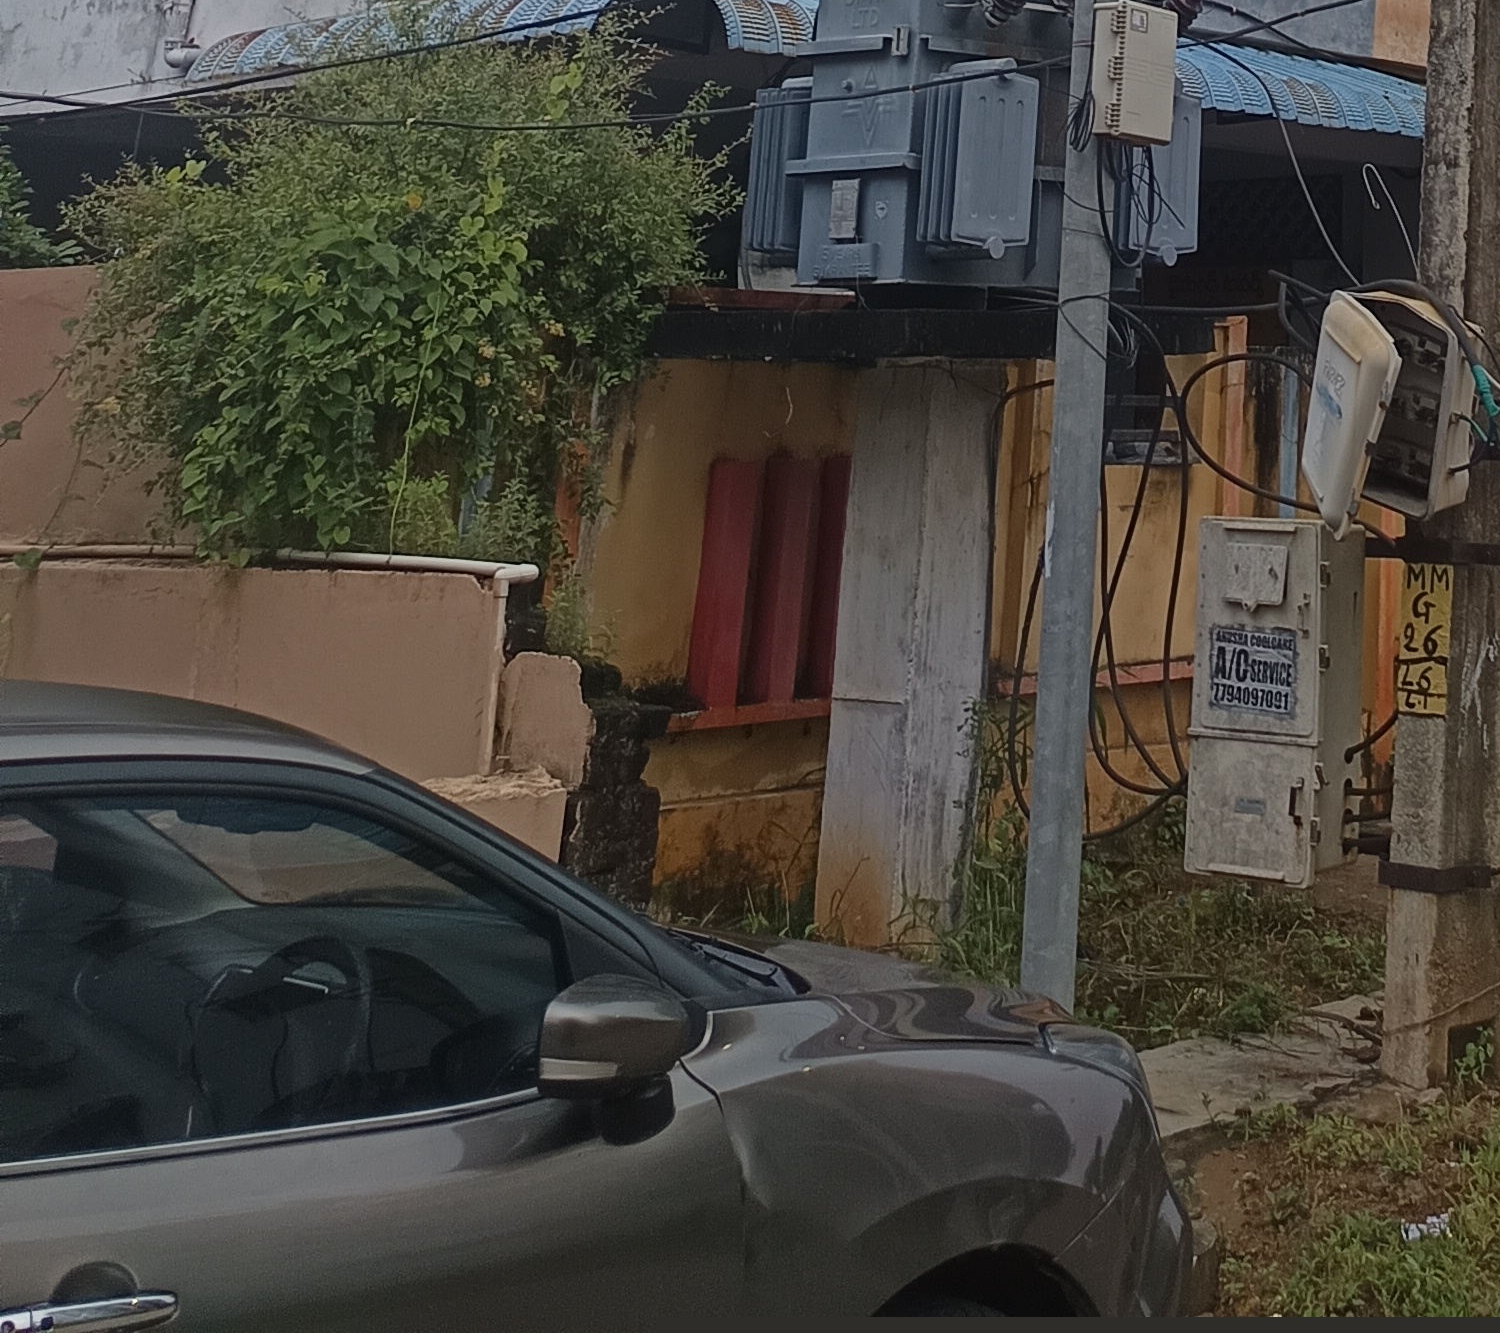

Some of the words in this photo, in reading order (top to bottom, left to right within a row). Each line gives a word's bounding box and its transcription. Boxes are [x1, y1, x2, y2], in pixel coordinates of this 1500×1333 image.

[1406, 564, 1450, 594] MM
[1412, 591, 1436, 625] G
[1403, 622, 1443, 657] 26
[1214, 646, 1251, 683] A/C
[1250, 659, 1292, 687] SERVICE
